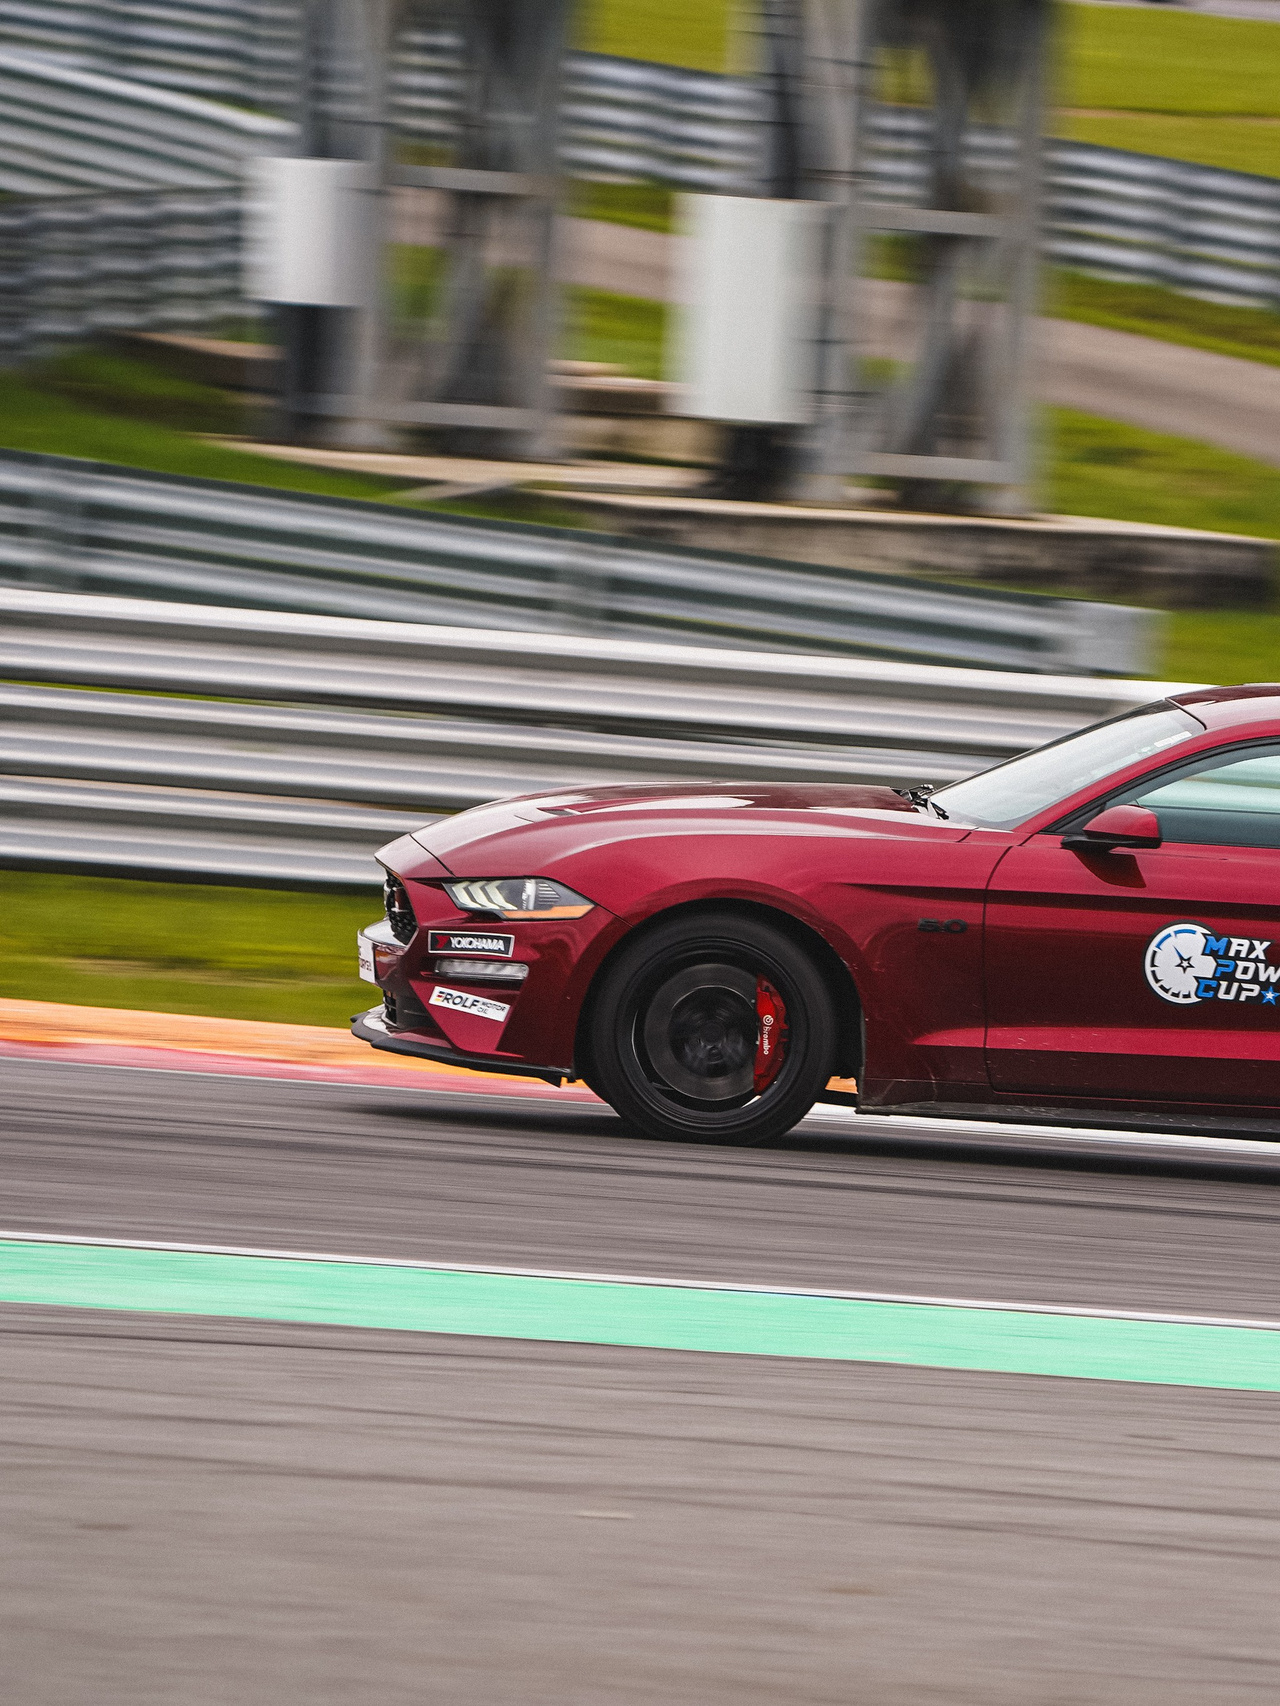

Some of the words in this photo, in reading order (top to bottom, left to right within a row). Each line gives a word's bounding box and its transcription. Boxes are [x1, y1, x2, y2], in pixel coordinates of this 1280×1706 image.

[450, 936, 504, 951] YOKOHAMA
[1204, 936, 1271, 960] MAX
[442, 993, 479, 1009] ROLF
[1197, 979, 1261, 1001] CUP
[763, 1026, 771, 1055] brembo
